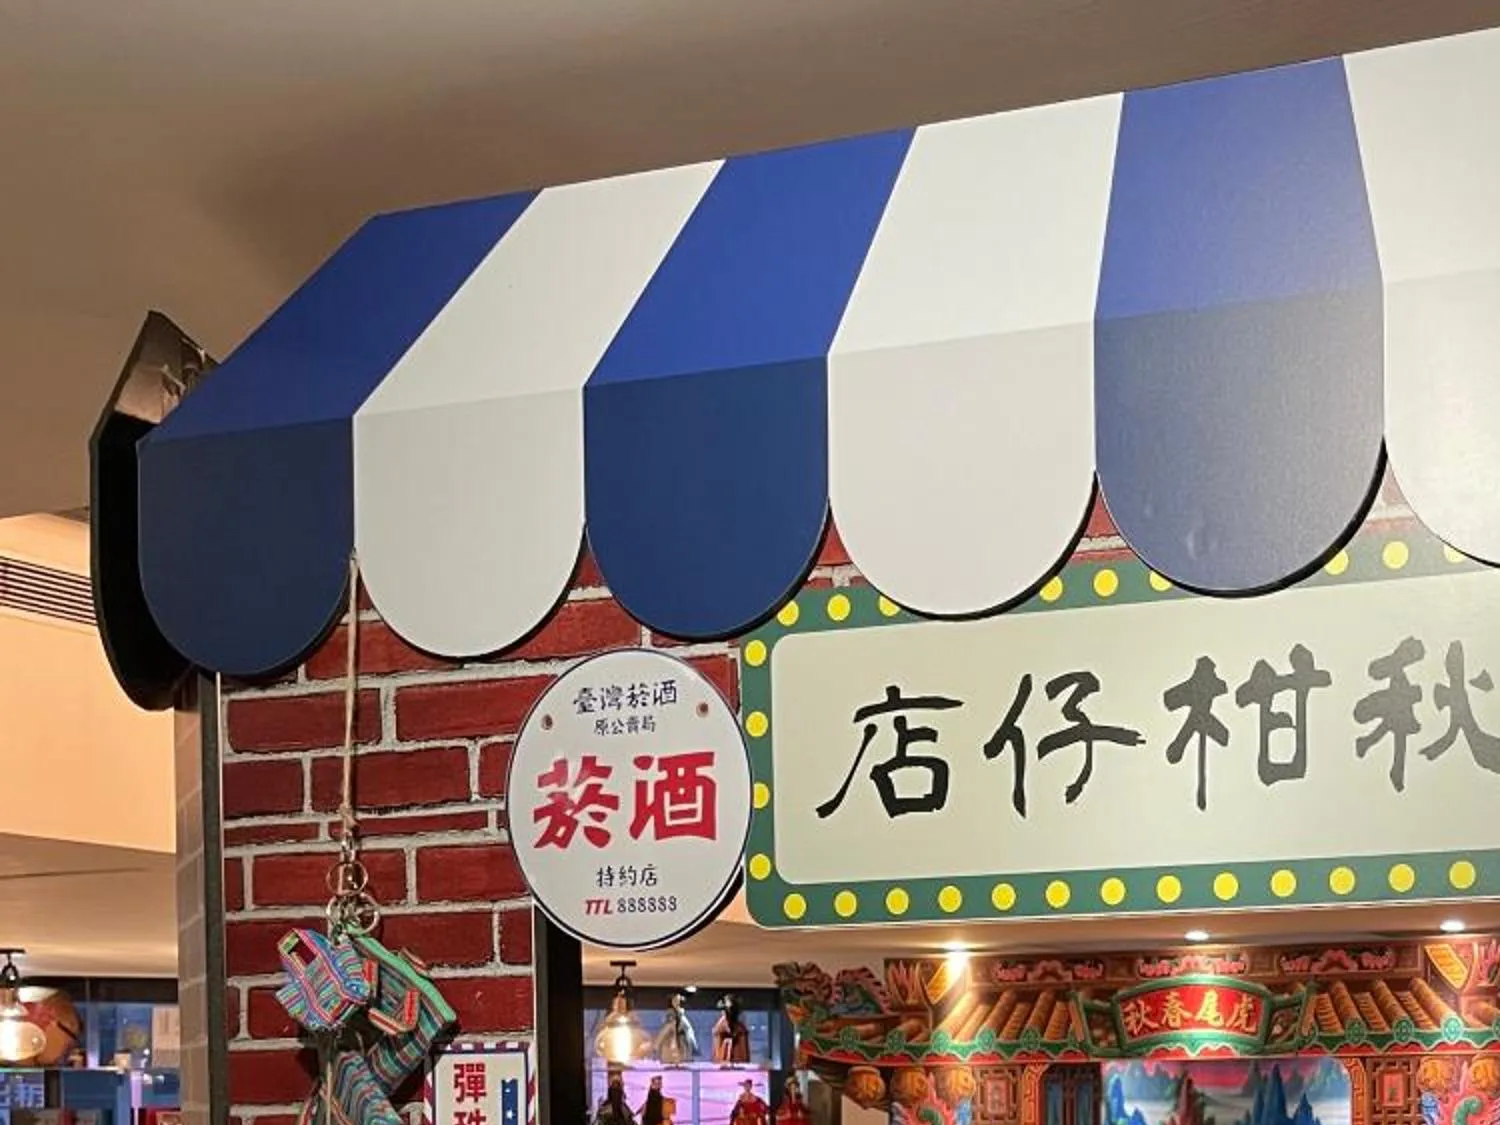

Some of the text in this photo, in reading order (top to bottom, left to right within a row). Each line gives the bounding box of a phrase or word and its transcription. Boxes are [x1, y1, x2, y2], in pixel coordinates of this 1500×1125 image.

[573, 679, 678, 714] 臺灣菸酒
[532, 750, 718, 849] 菸酒
[596, 864, 658, 888] 特約店
[585, 896, 678, 916] TTL 888888
